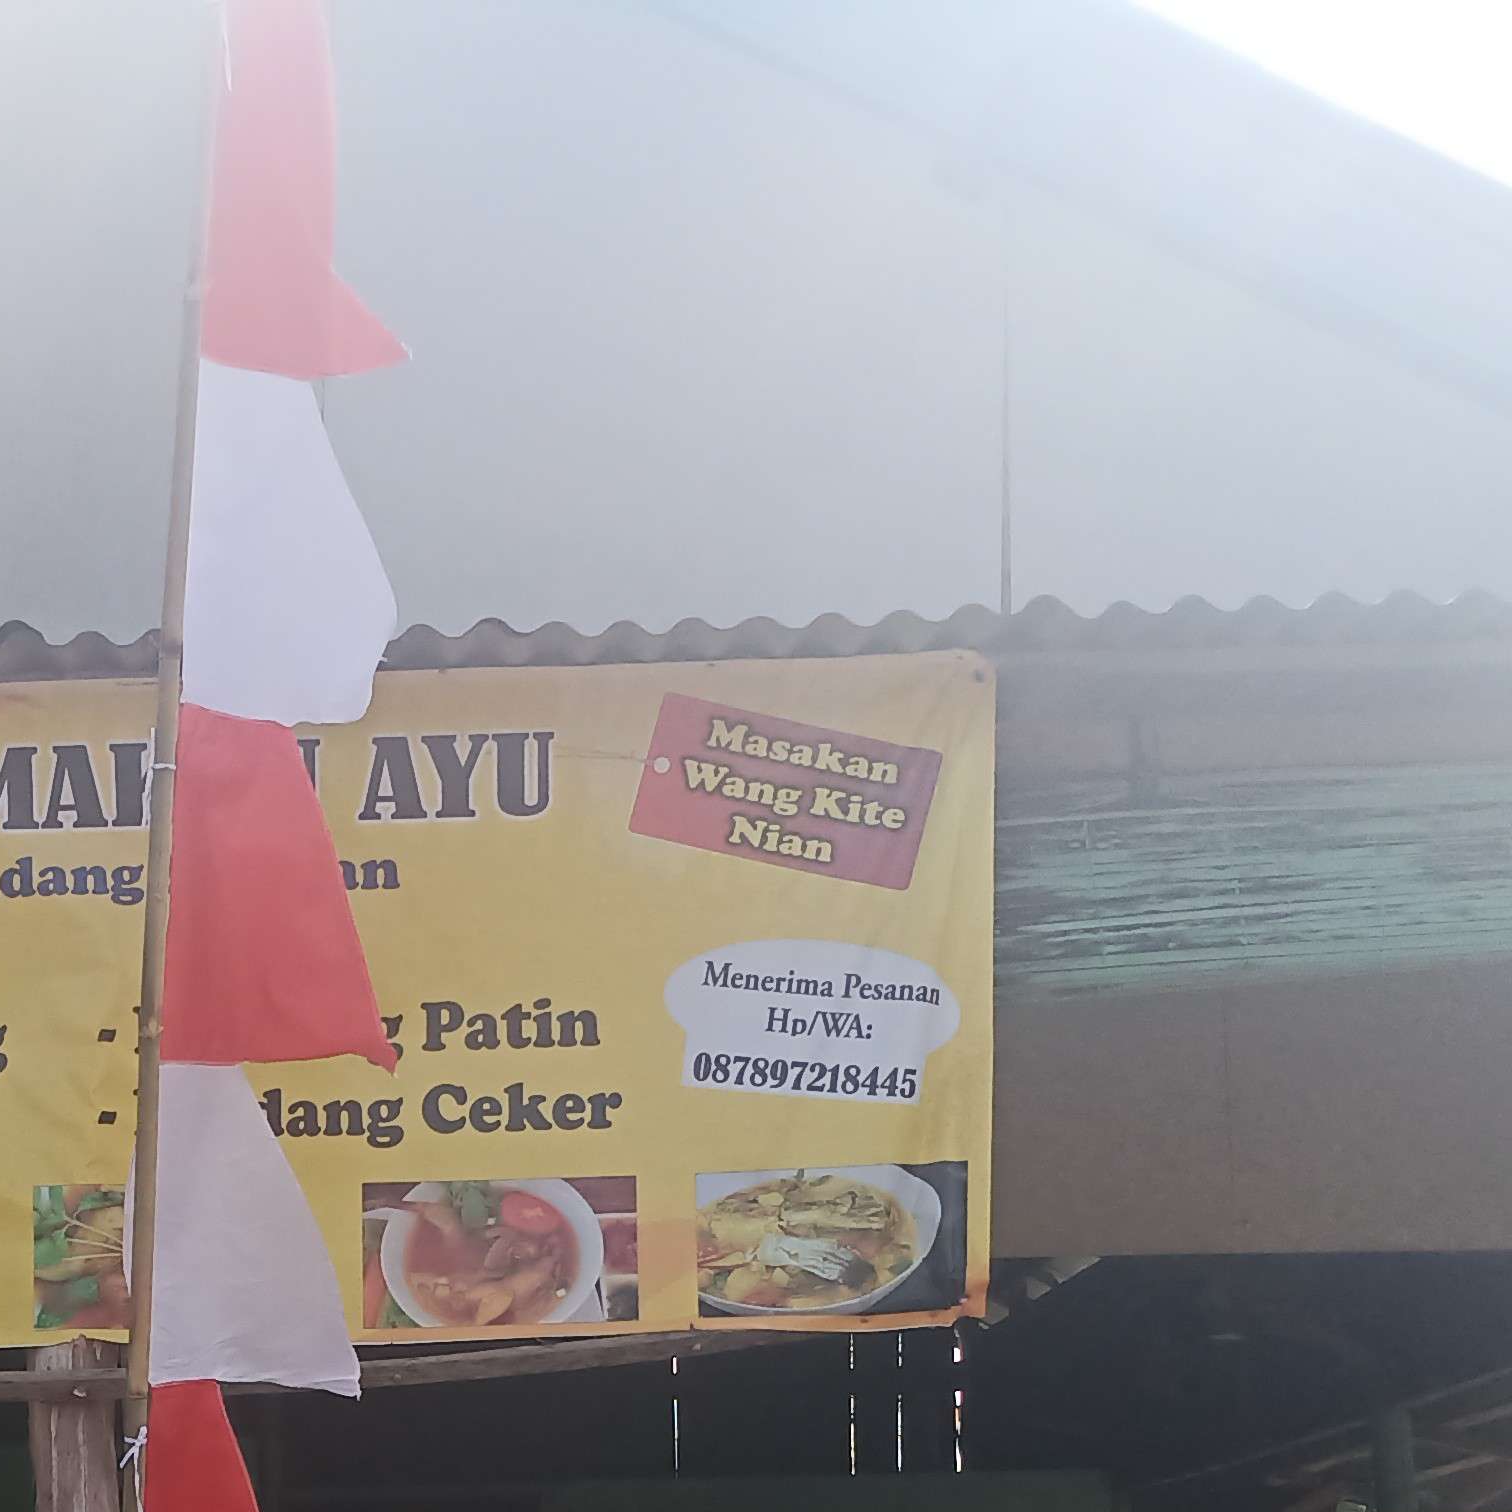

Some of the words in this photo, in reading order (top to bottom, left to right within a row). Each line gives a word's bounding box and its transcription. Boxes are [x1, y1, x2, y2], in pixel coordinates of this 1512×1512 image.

[357, 731, 556, 821] AYU
[707, 718, 899, 784] Masakan
[683, 758, 803, 816] Wang
[809, 787, 906, 829] Kite
[728, 816, 833, 863] Nian
[701, 960, 834, 999] Menerima
[841, 972, 940, 1006] Pesanan
[419, 997, 601, 1053] Patin
[765, 1006, 873, 1040] Hp/WA:
[692, 1051, 918, 1099] 087897218445
[421, 1080, 623, 1136] Ceker
